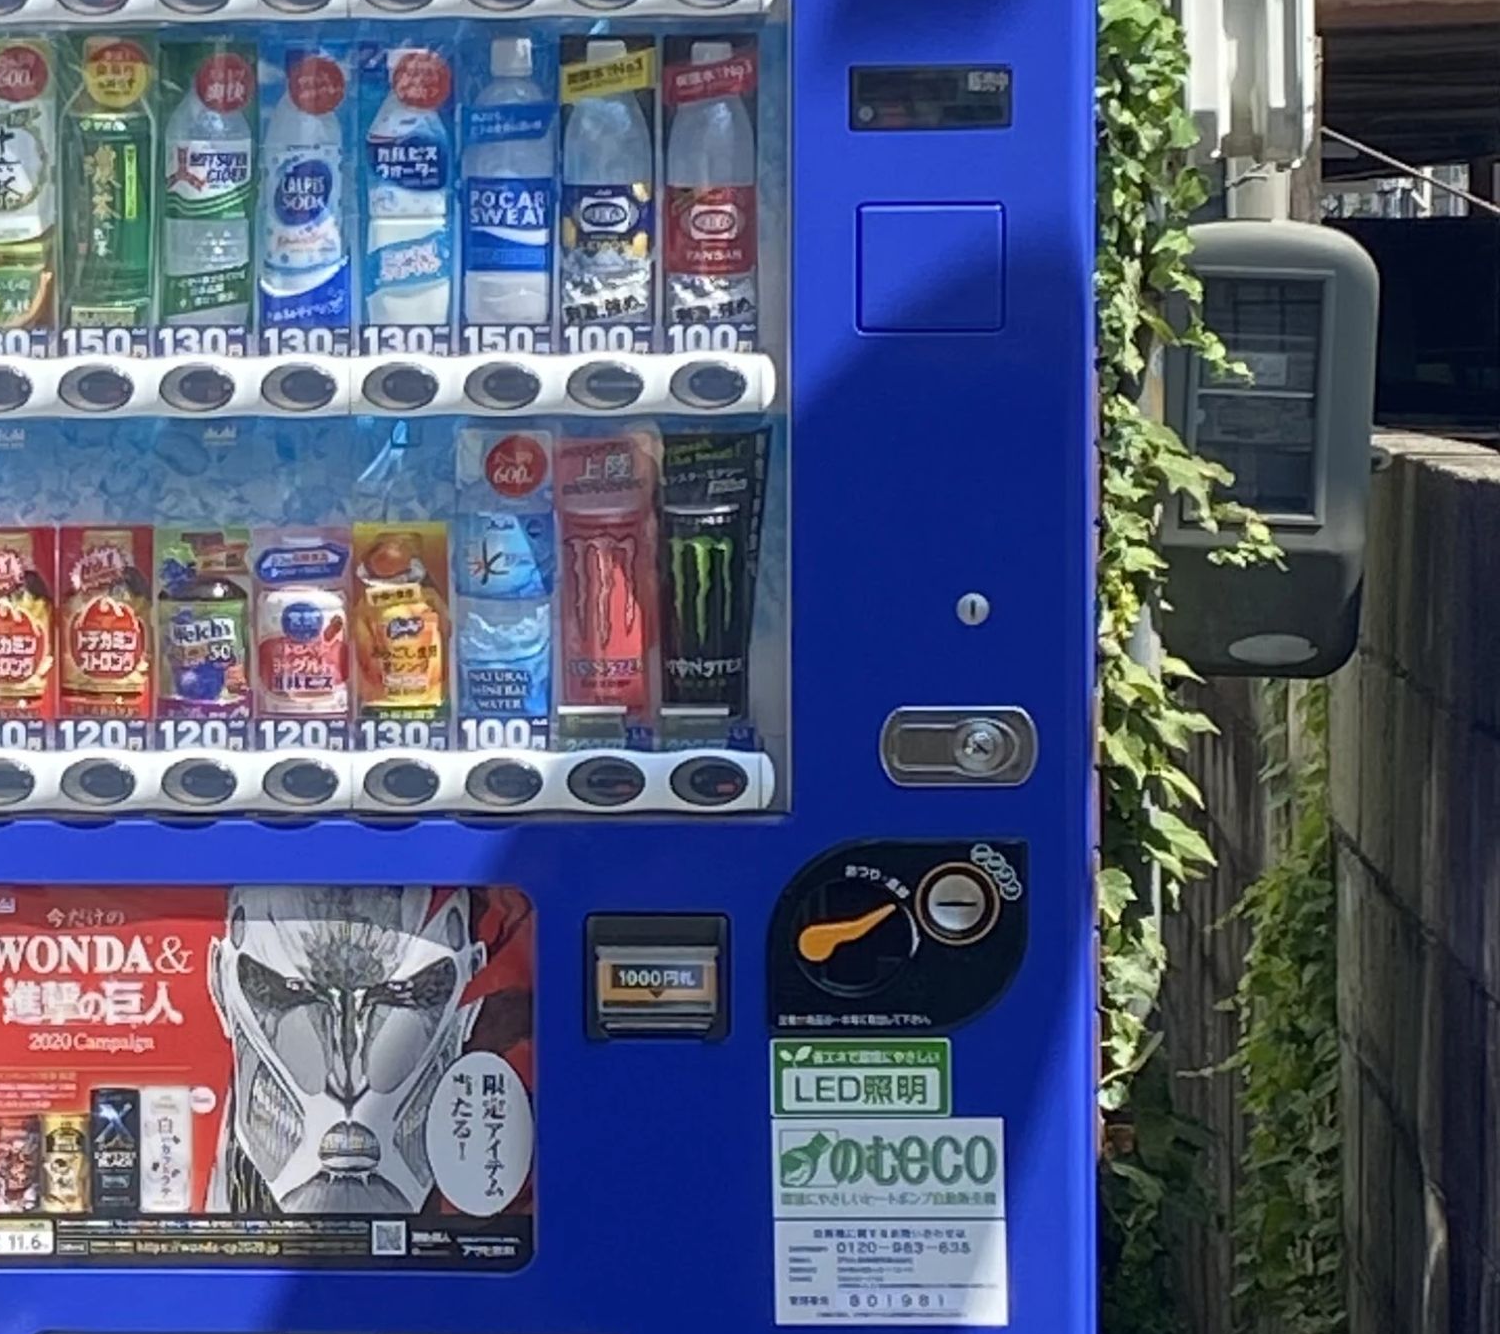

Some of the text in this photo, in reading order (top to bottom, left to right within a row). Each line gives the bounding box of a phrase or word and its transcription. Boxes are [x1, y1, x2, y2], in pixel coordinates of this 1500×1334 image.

[376, 145, 438, 162] カルピス
[375, 162, 439, 180] ウォーター
[281, 193, 328, 212] SODA
[469, 206, 545, 227] SWEAT
[172, 618, 235, 643] Welch's
[79, 652, 136, 673] ストロング
[476, 697, 523, 710] WATER
[155, 934, 196, 975] &
[617, 968, 696, 989] 1000円札
[2, 976, 185, 1027] 進撃の巨人
[28, 1032, 156, 1054] 2020 Campaign
[794, 1074, 928, 1105] LED照明
[481, 1072, 506, 1198] 限定アイテム
[830, 1133, 997, 1187] のむeco
